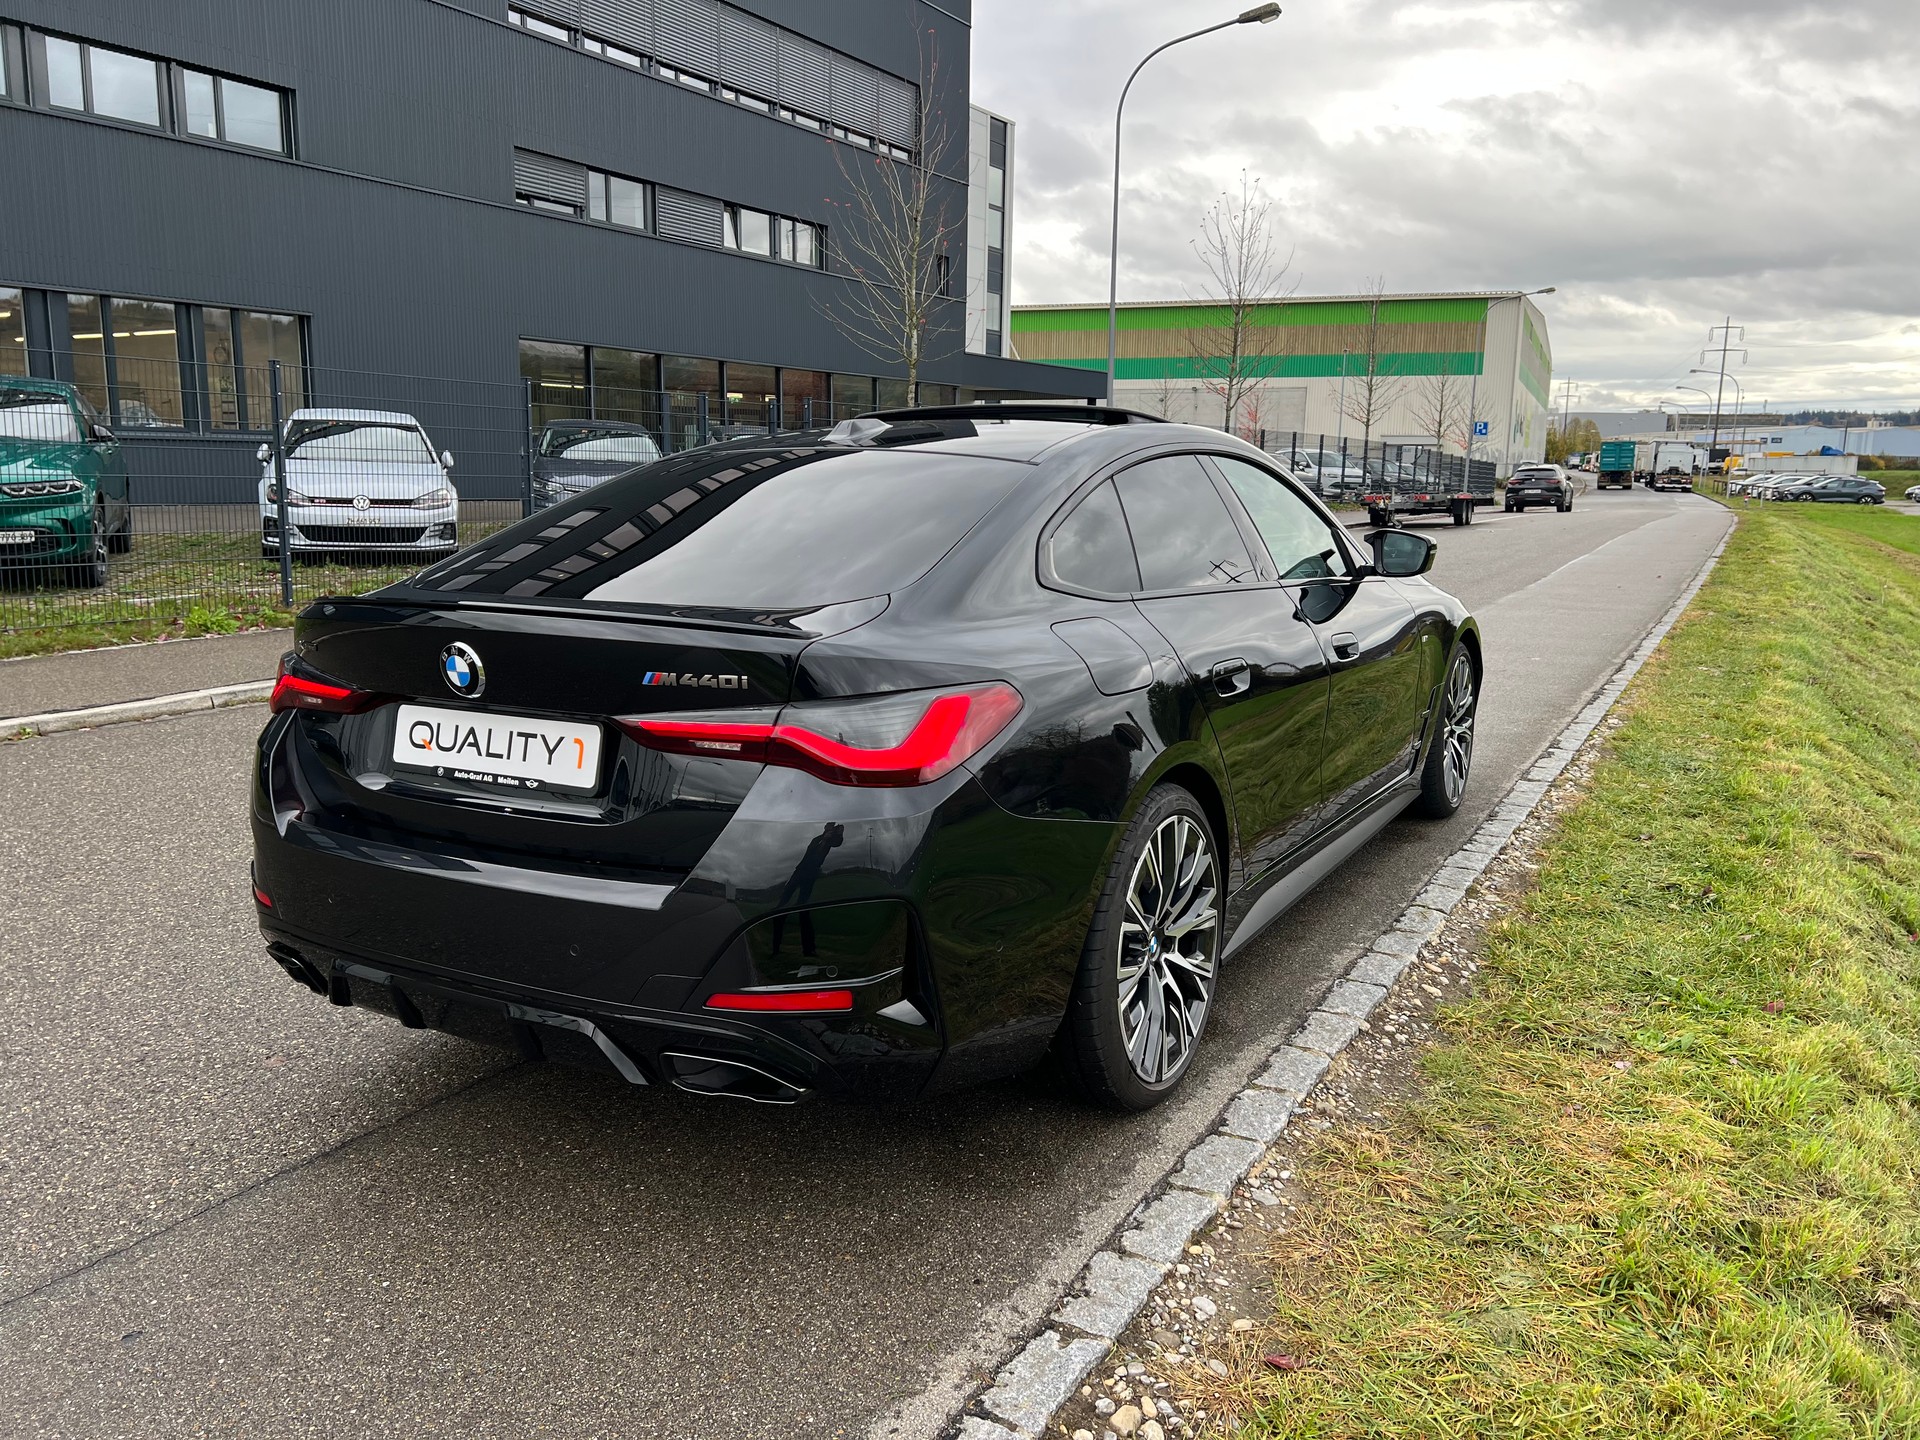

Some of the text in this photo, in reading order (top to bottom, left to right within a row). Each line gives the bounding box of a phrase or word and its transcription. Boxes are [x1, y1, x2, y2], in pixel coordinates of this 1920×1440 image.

[1476, 422, 1484, 432] P
[442, 645, 473, 664] BMW
[658, 672, 749, 690] M440i
[409, 720, 584, 770] QUALITY 1
[454, 770, 483, 781] Auto-Graf
